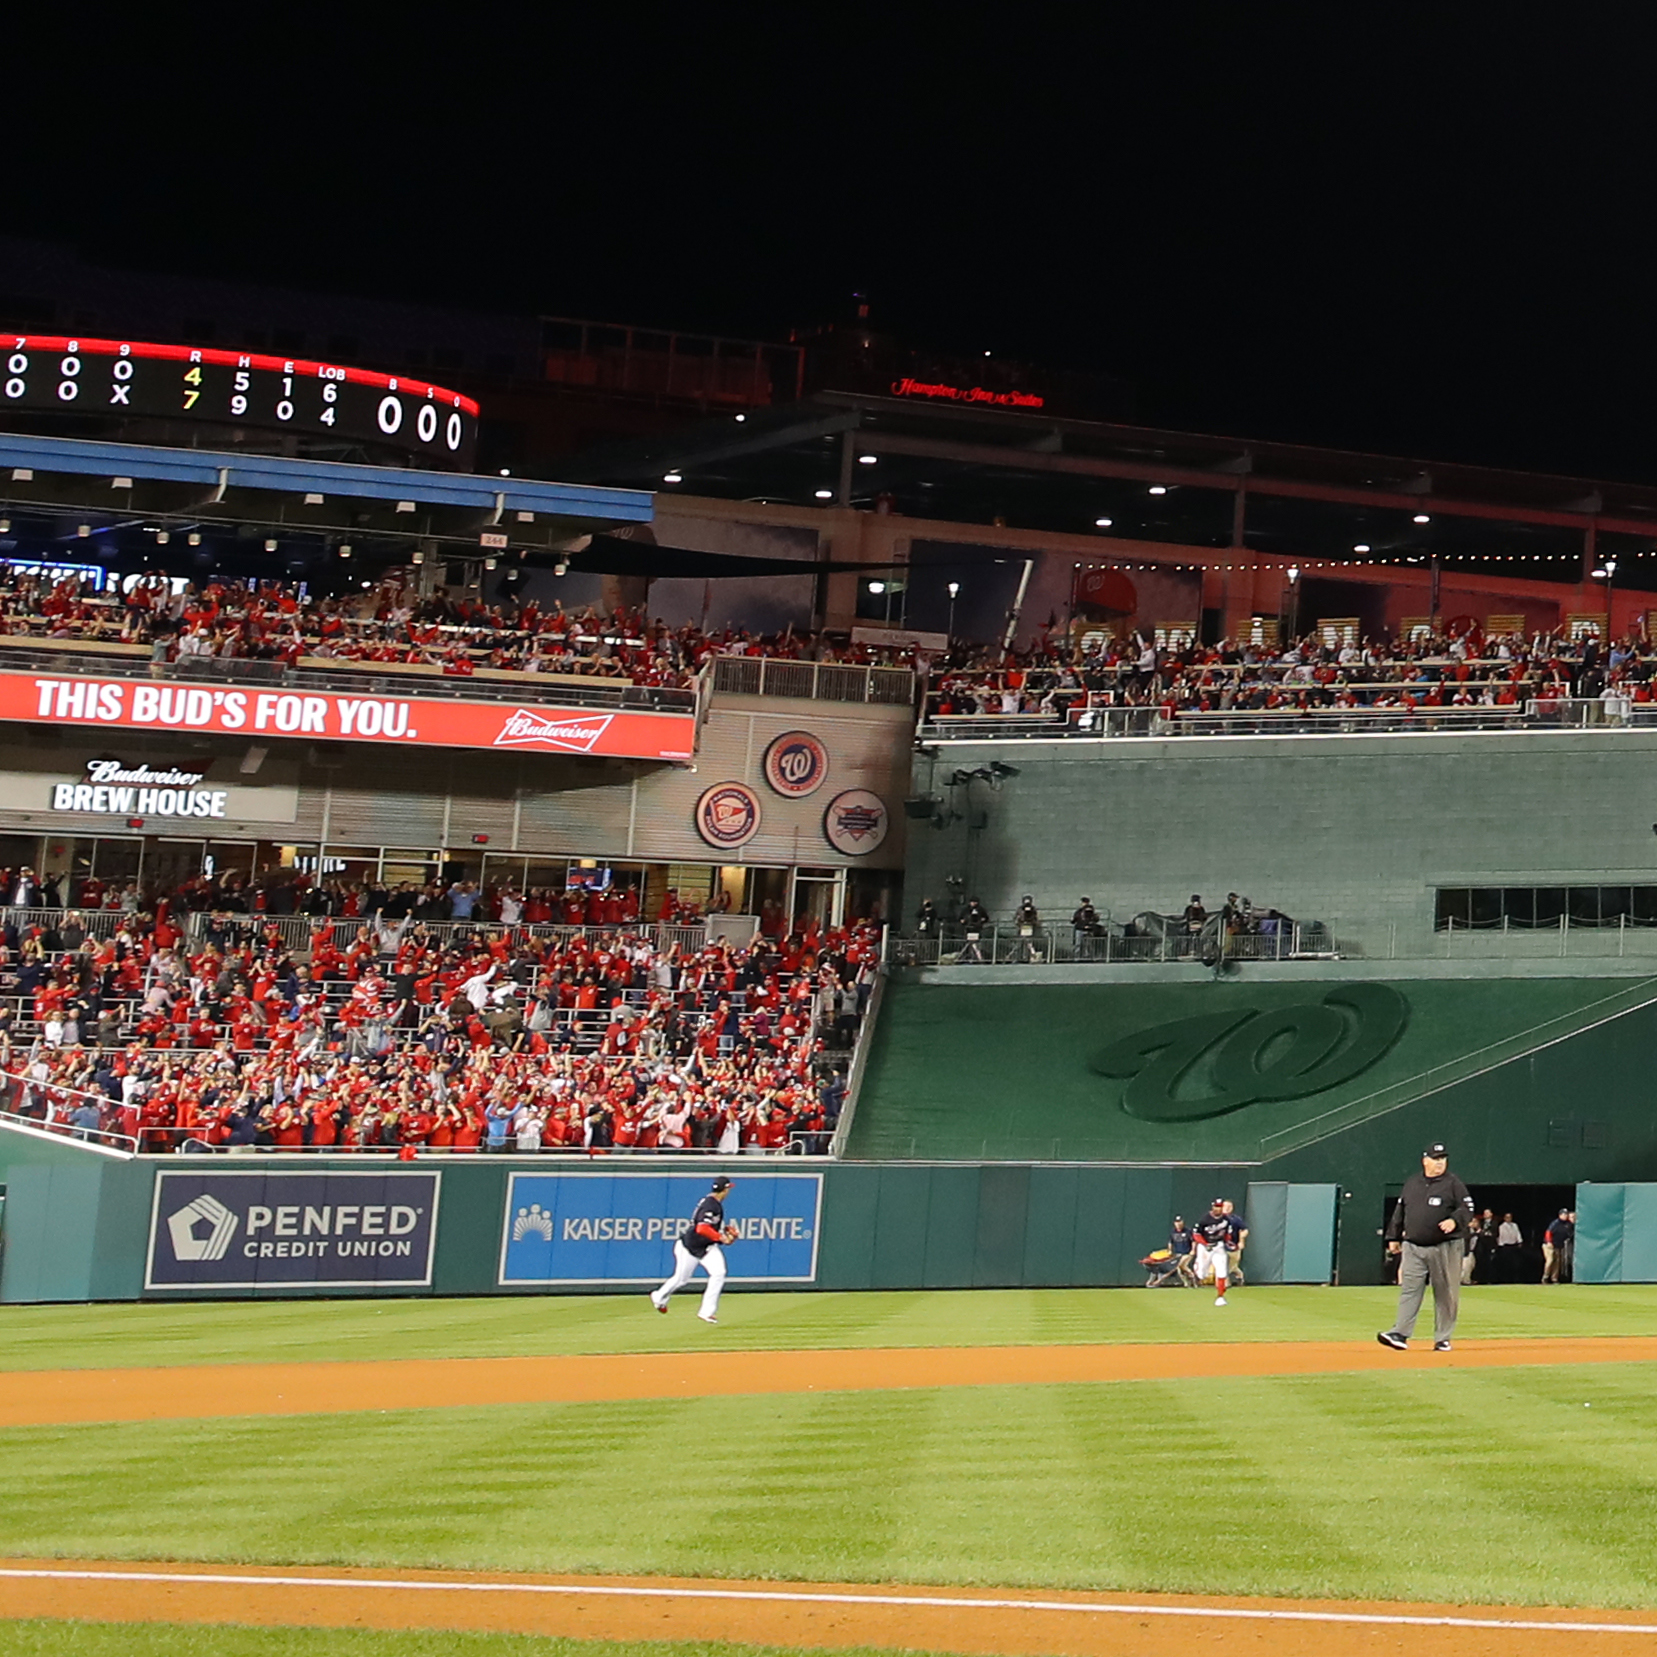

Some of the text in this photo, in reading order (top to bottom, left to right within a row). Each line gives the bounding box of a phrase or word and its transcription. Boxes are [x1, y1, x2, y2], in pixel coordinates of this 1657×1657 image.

[15, 338, 26, 349] 7
[67, 341, 78, 352] 8
[119, 344, 130, 356] 9
[190, 351, 202, 362] R
[238, 356, 250, 367] H
[284, 362, 294, 373] E
[318, 366, 346, 381] LOB
[389, 378, 397, 390] B
[184, 367, 202, 386] 4
[234, 372, 250, 391] 5
[282, 378, 292, 397] 1
[323, 383, 337, 402] 6
[183, 391, 200, 410] 7
[231, 395, 247, 415] 9
[277, 401, 294, 421] 0
[320, 407, 336, 426] 4
[377, 396, 402, 434] 0
[417, 405, 437, 442] 0
[35, 680, 418, 738] THIS BUD'S FOR YOU.
[505, 716, 601, 741] Budweiser
[87, 761, 203, 786] Budweiser
[54, 784, 227, 817] BREW HOUSE
[247, 1206, 418, 1235] PENFED
[563, 1217, 804, 1240] KAISER PERNENTE
[243, 1241, 411, 1258] CREDIT UNION
